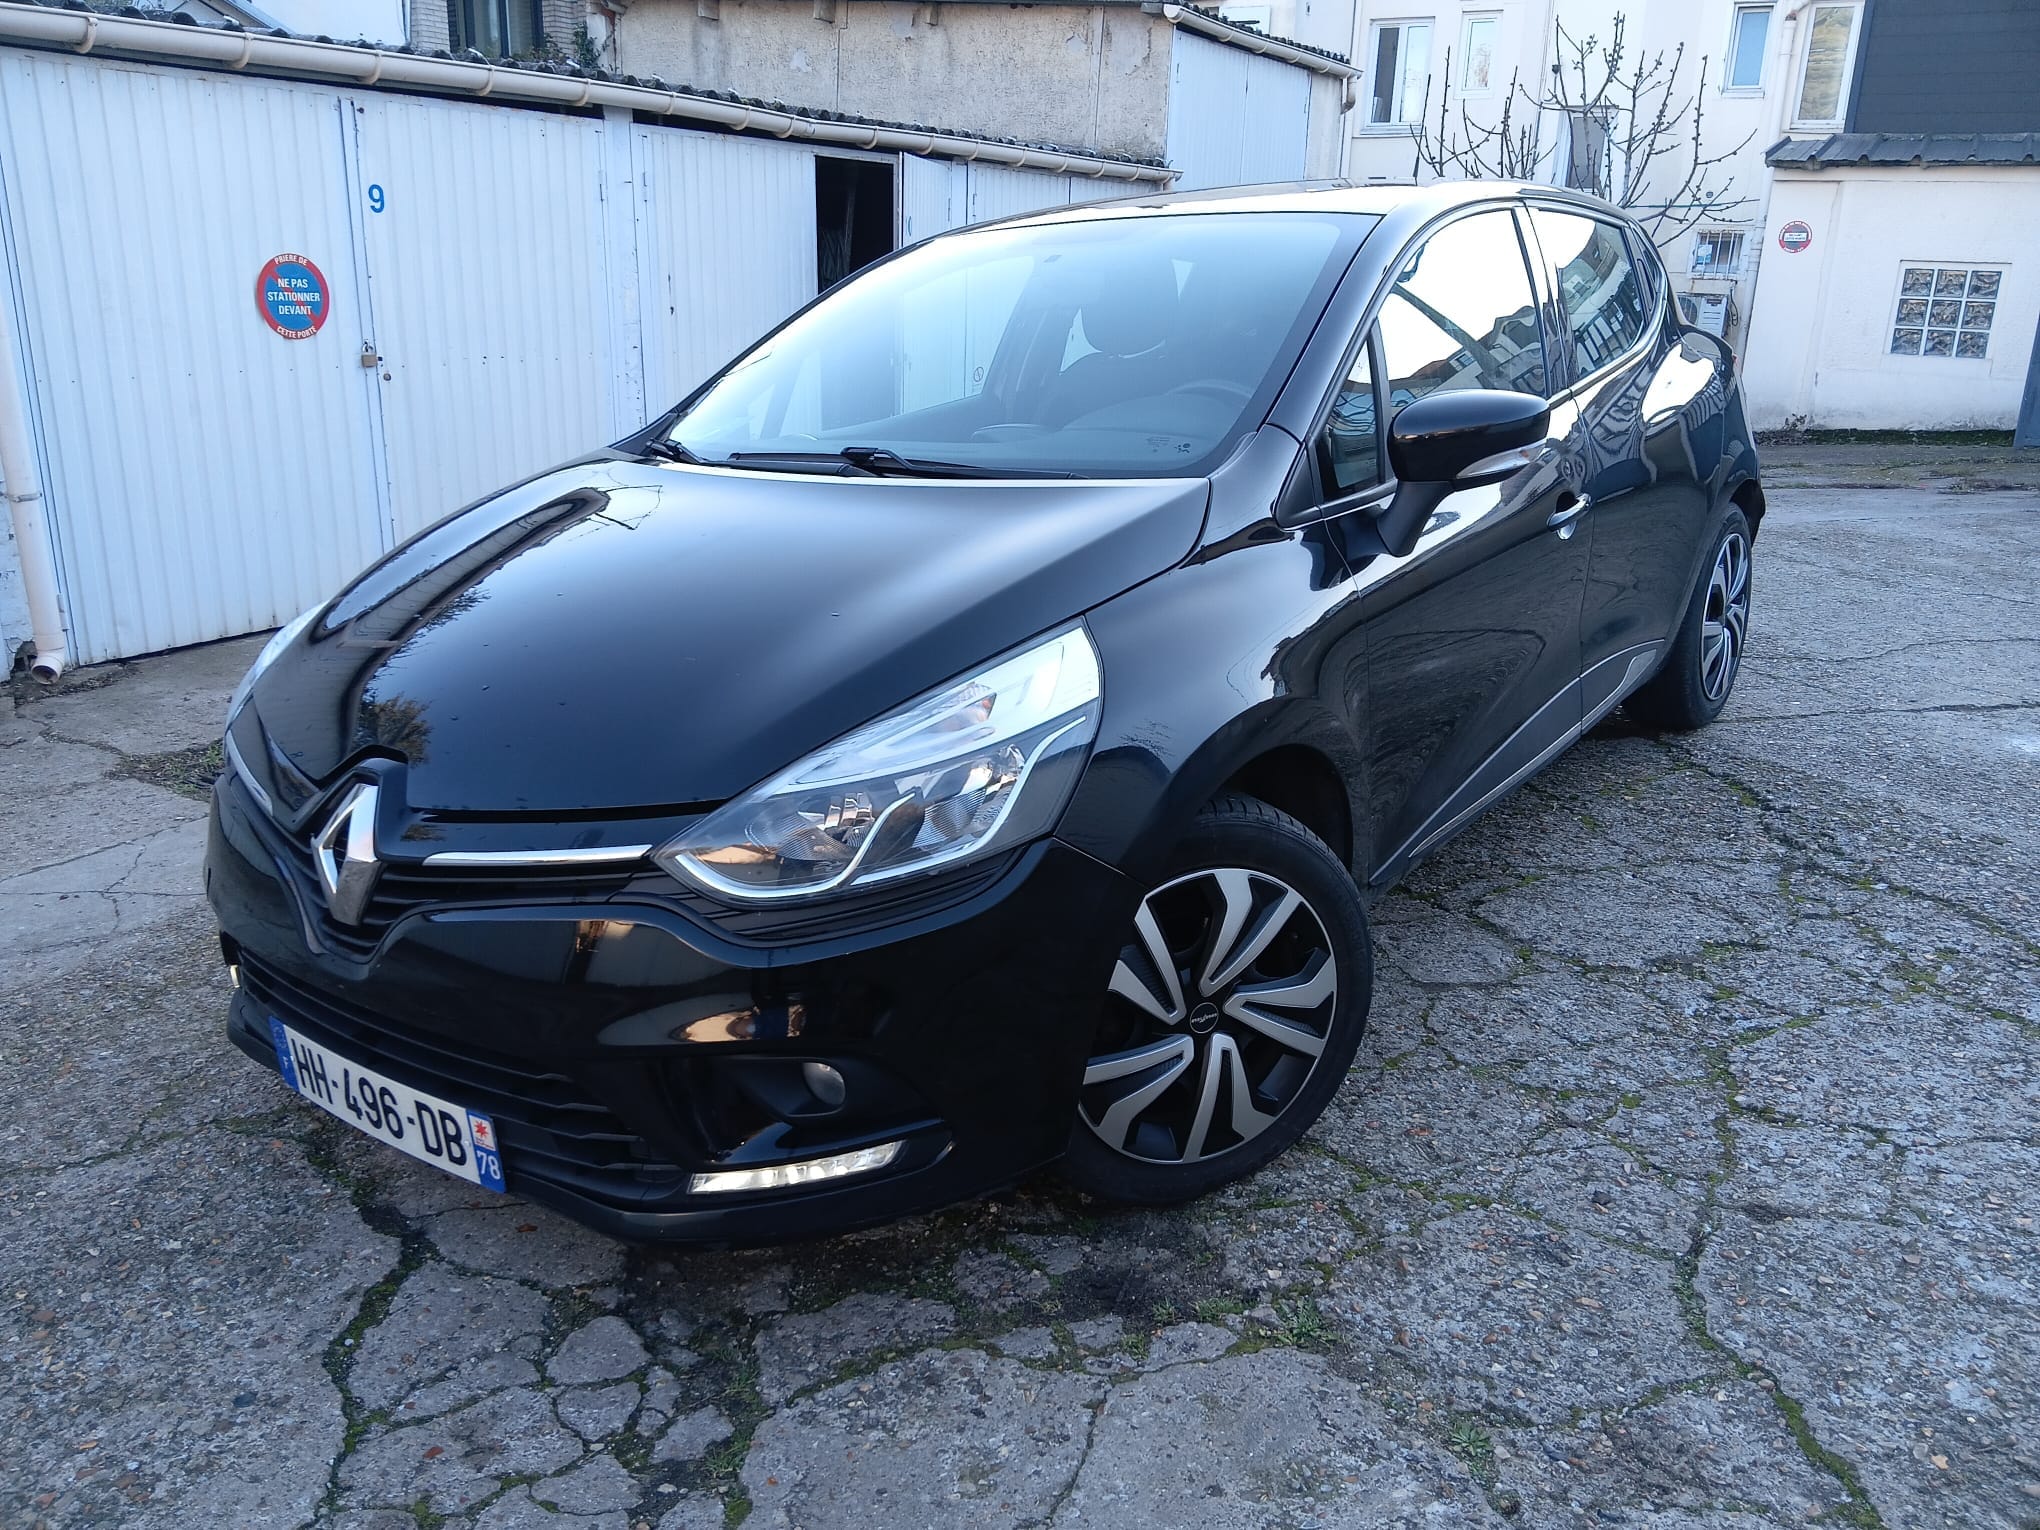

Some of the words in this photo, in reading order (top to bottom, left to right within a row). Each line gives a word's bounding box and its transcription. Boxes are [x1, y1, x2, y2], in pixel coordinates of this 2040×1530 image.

[368, 184, 385, 213] 9
[298, 257, 308, 266] DE
[277, 278, 290, 288] NE
[291, 278, 308, 288] PAS
[267, 291, 320, 302] STATIONNER
[278, 305, 312, 315] DEVANT
[276, 325, 297, 339] CETTE
[297, 325, 317, 339] PORTE
[291, 1038, 467, 1166] HH-496-DB
[476, 1150, 501, 1180] 78
